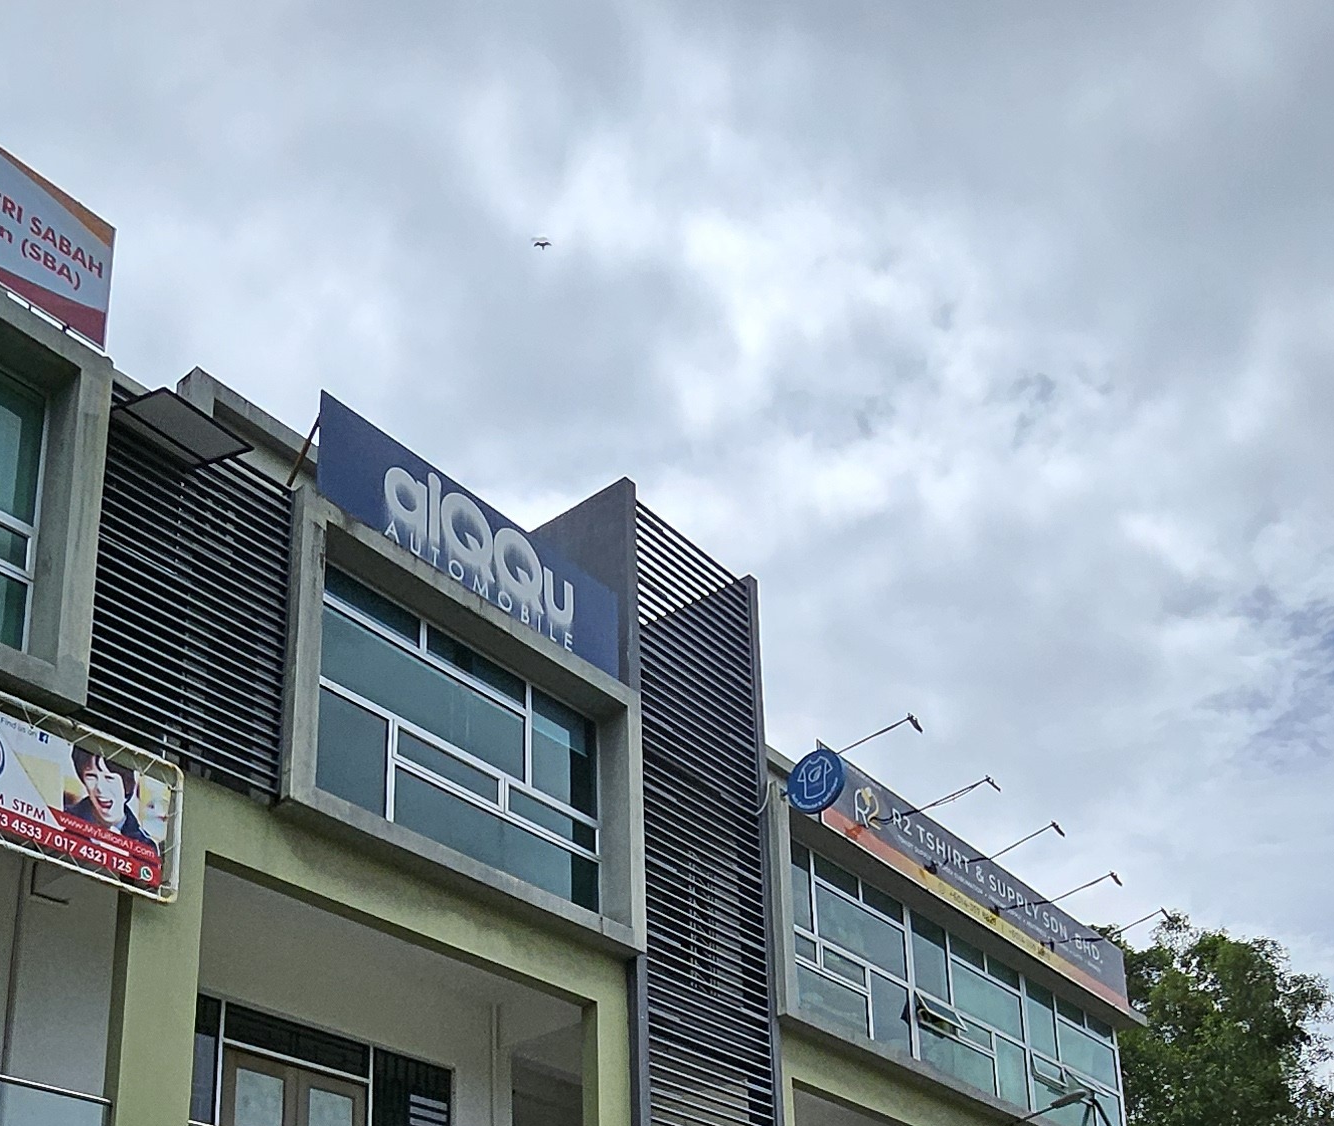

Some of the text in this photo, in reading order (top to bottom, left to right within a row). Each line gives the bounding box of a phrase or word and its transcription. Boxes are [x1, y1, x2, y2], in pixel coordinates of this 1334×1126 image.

[21, 238, 81, 291] (SBA)
[30, 216, 104, 279] SABAH
[384, 521, 574, 653] AUTOMOBILE
[0, 717, 18, 730] Find
[28, 728, 38, 738] on
[12, 798, 46, 821] STPM
[12, 819, 42, 840] 4533
[54, 835, 77, 852] 017
[79, 846, 107, 864] 4321
[112, 857, 132, 873] 125
[892, 808, 912, 836] R2
[916, 825, 970, 873] TSHIRT
[976, 866, 985, 884] &
[988, 874, 1039, 919] SUPPLY
